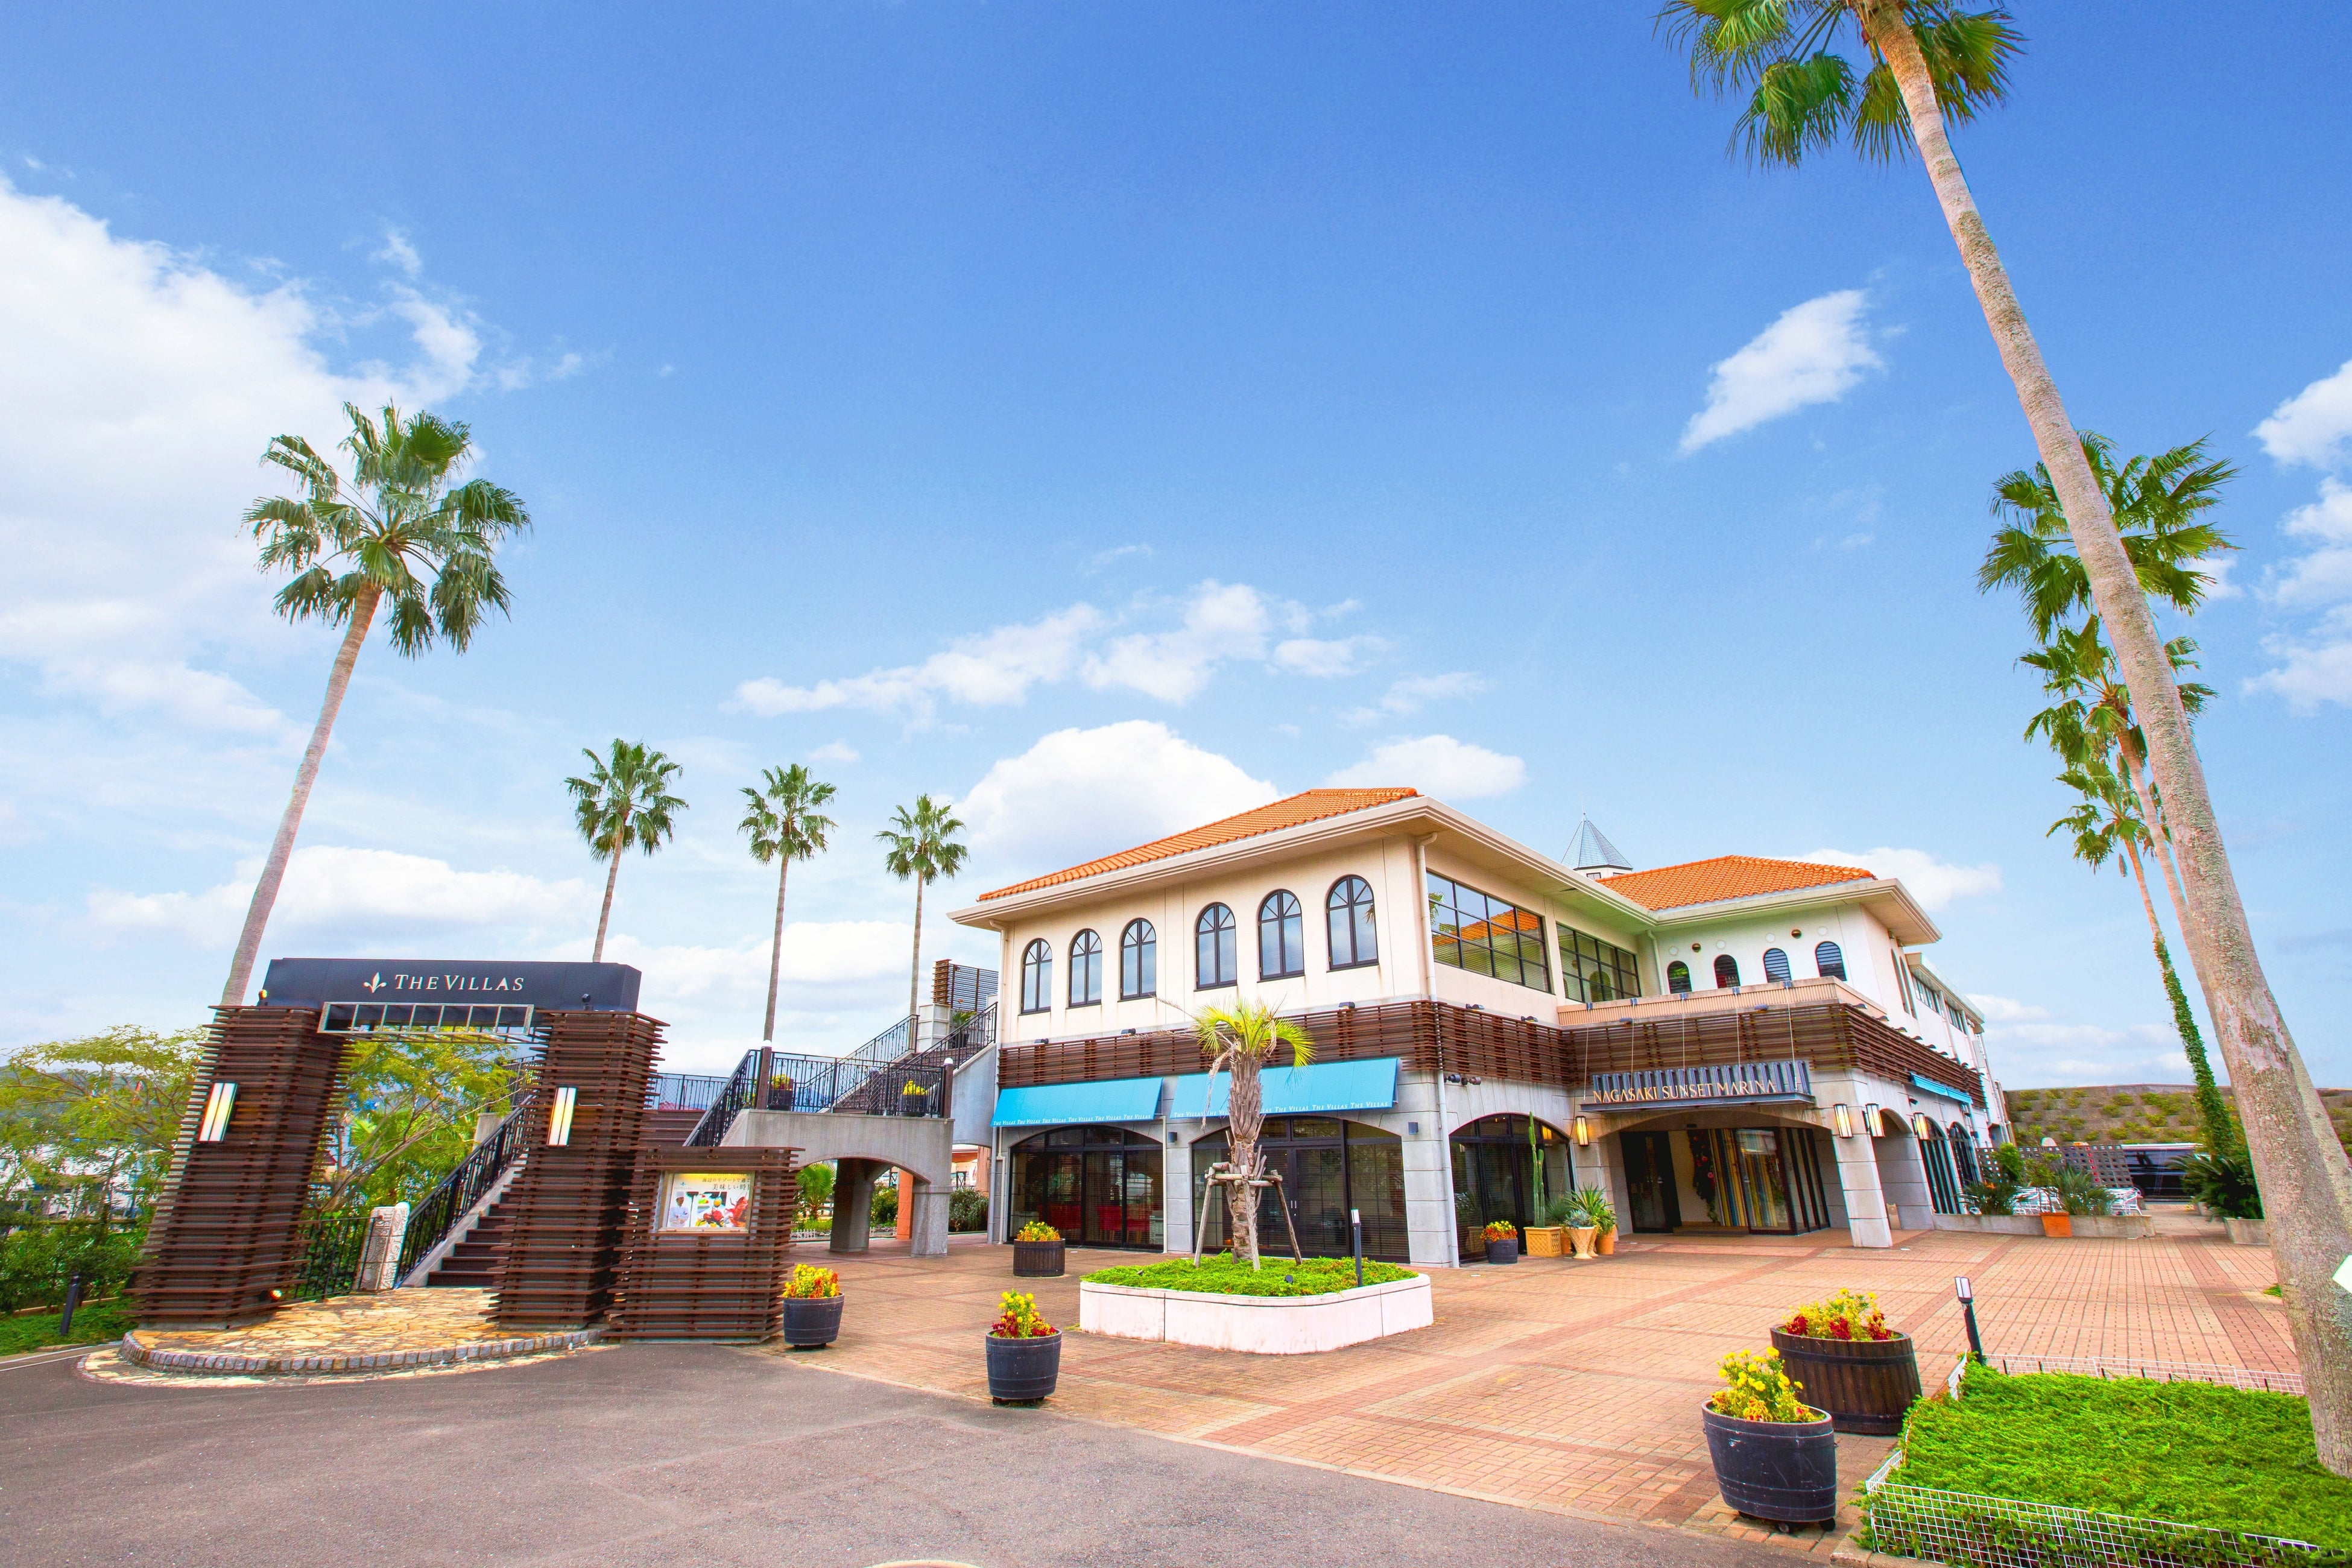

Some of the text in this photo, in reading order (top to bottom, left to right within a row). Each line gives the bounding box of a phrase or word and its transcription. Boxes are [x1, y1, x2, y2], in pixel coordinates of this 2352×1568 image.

[394, 974, 524, 991] THE VILLAS
[1593, 1079, 1777, 1102] NAGASAKI SUNSET MARINA
